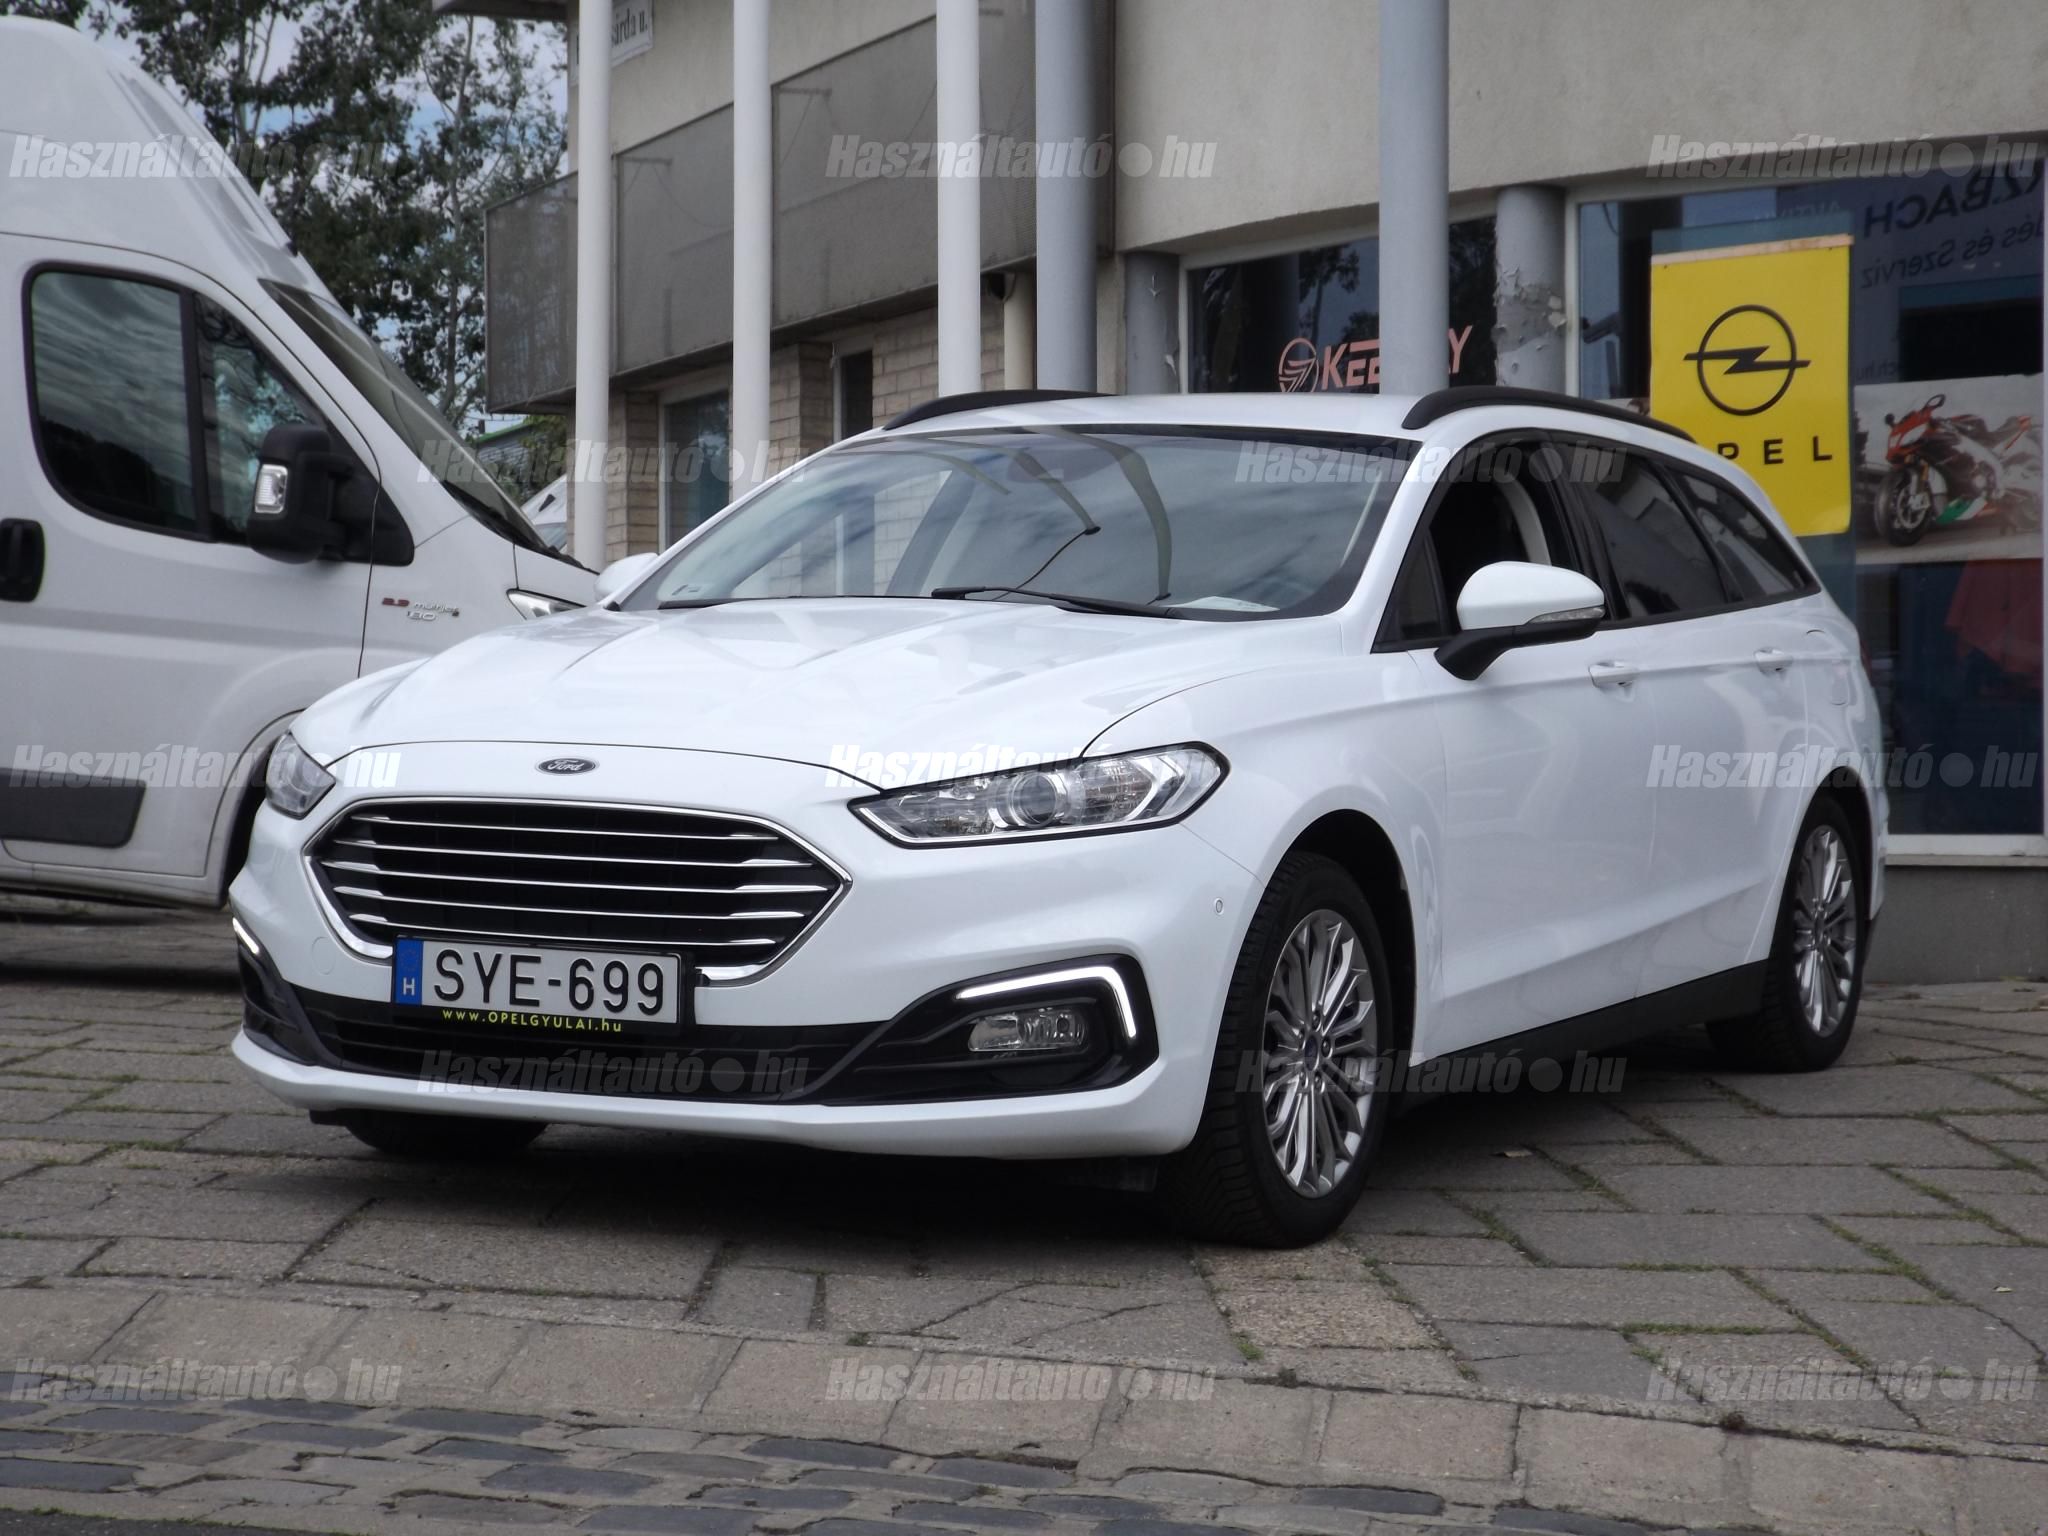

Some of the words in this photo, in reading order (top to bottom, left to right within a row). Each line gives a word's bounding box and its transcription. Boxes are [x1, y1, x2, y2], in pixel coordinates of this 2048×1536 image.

[1321, 325, 1473, 390] KEEY
[1717, 435, 1833, 465] PEL
[402, 977, 416, 997] H
[433, 948, 665, 1017] SYE-699
